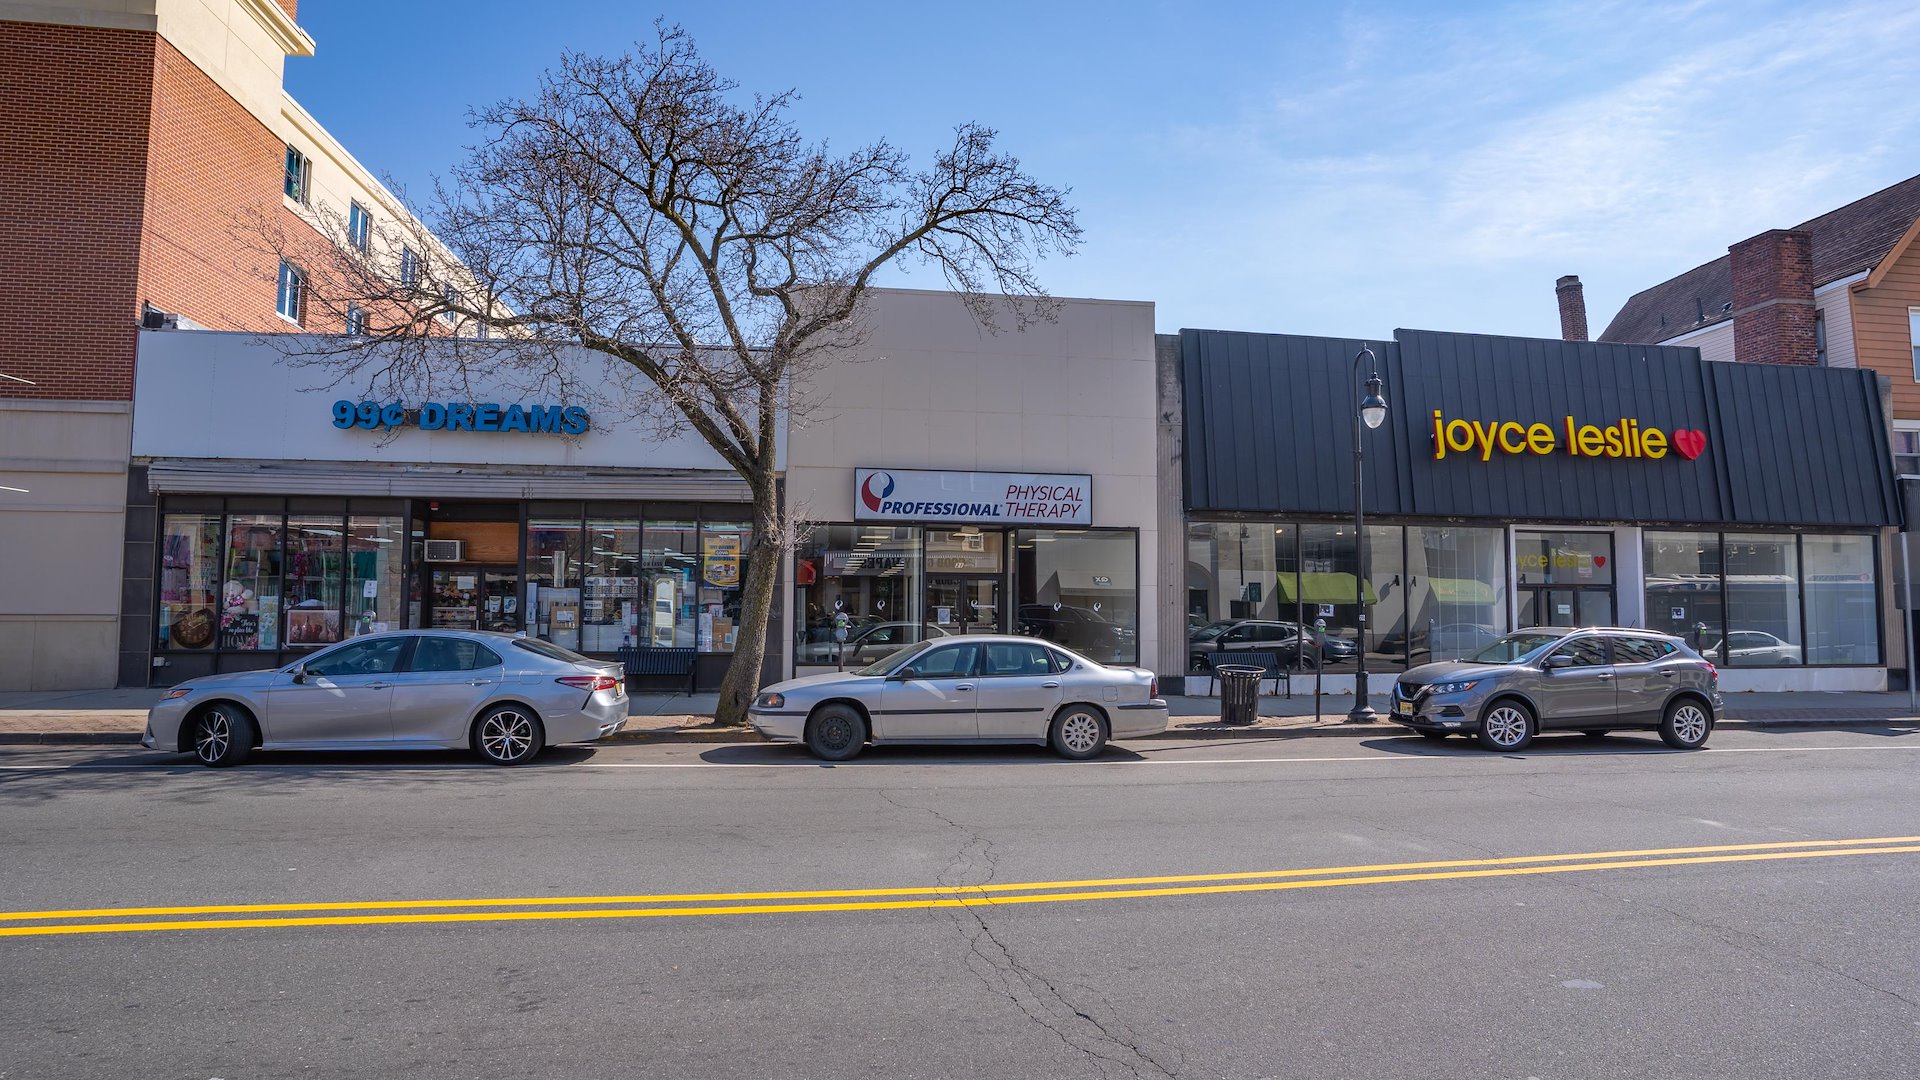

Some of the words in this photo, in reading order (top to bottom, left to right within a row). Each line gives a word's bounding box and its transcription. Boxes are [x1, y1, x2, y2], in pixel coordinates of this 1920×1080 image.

[332, 400, 404, 432] 99¢
[418, 401, 591, 435] DREAMS
[1432, 409, 1555, 462] joyce
[1564, 415, 1668, 460] leslie
[1006, 484, 1083, 502] PHYSICAL
[881, 501, 1001, 517] PROFESSIONAL
[1005, 501, 1082, 519] THERAPY
[1516, 554, 1549, 571] yce
